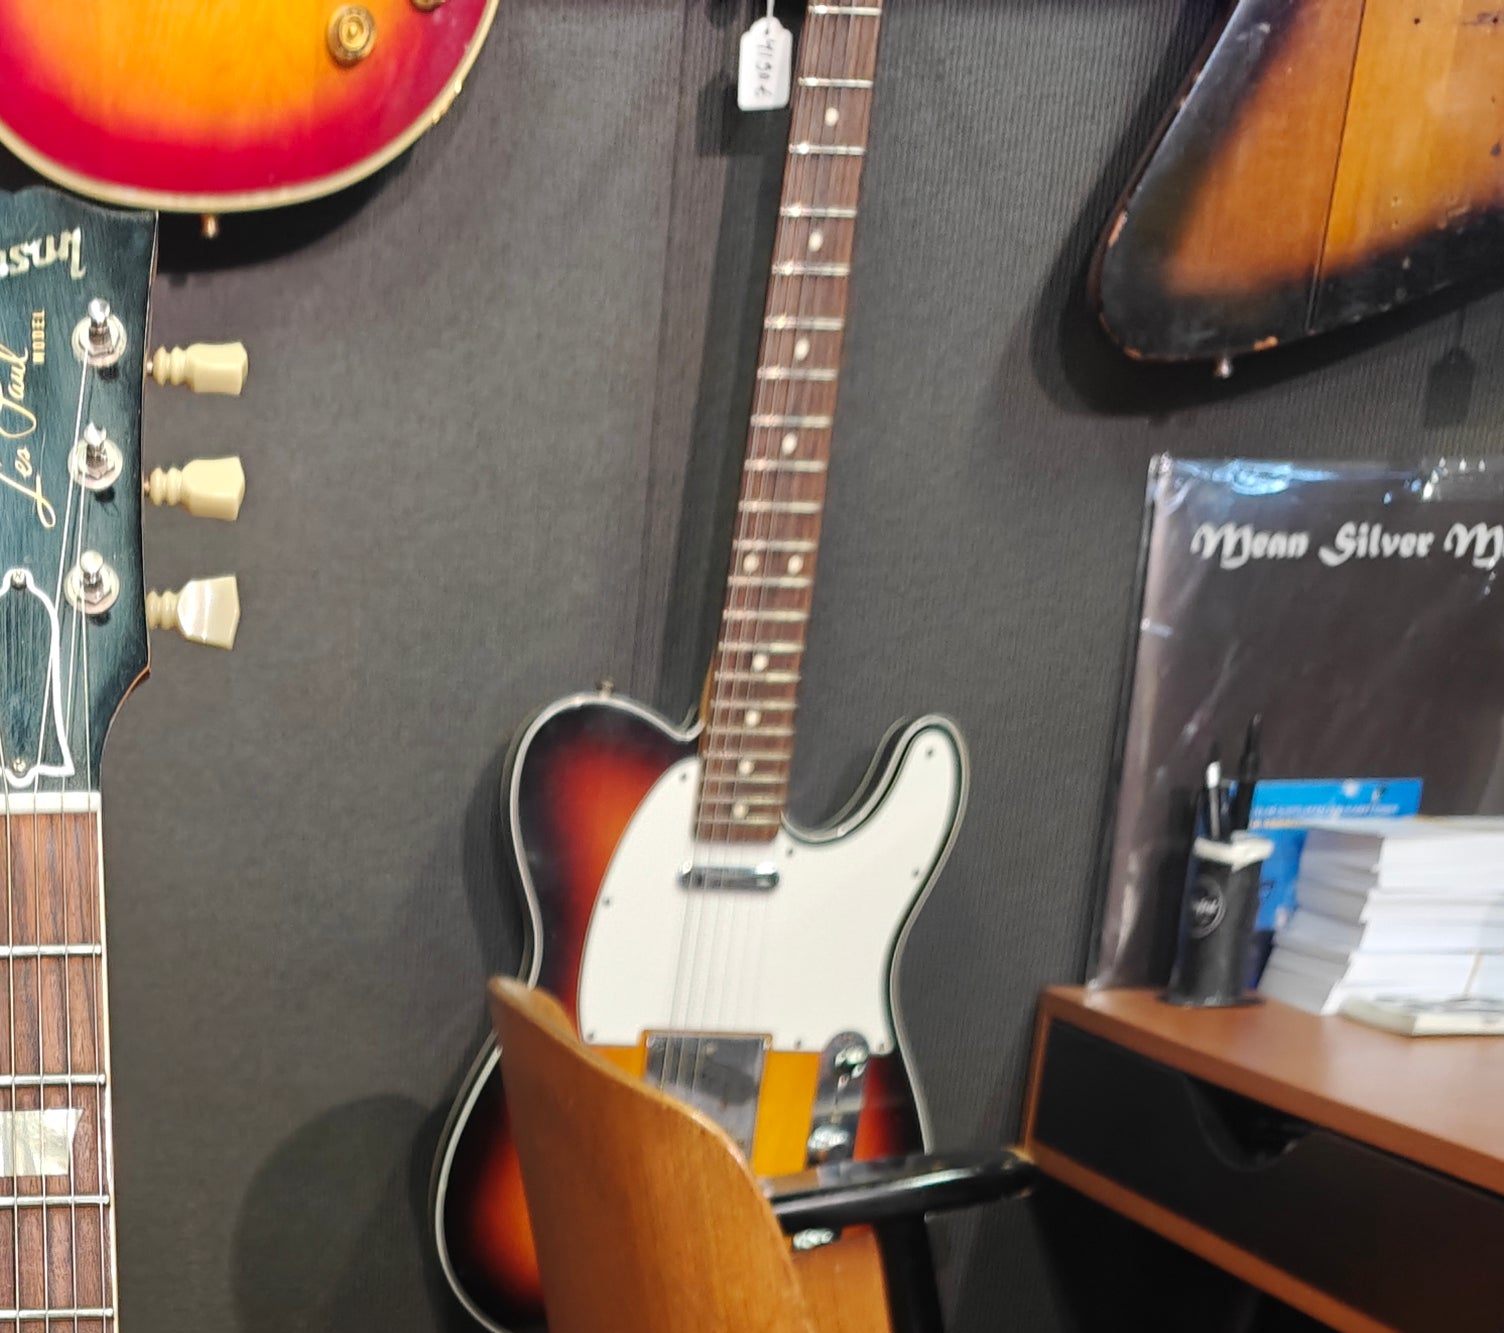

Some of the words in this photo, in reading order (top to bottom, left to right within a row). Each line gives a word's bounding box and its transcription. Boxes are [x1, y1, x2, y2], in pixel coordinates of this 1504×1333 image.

[32, 308, 45, 365] MODEL
[1189, 521, 1310, 570] Mean
[1317, 520, 1435, 567] Silver
[1442, 521, 1504, 570] M
